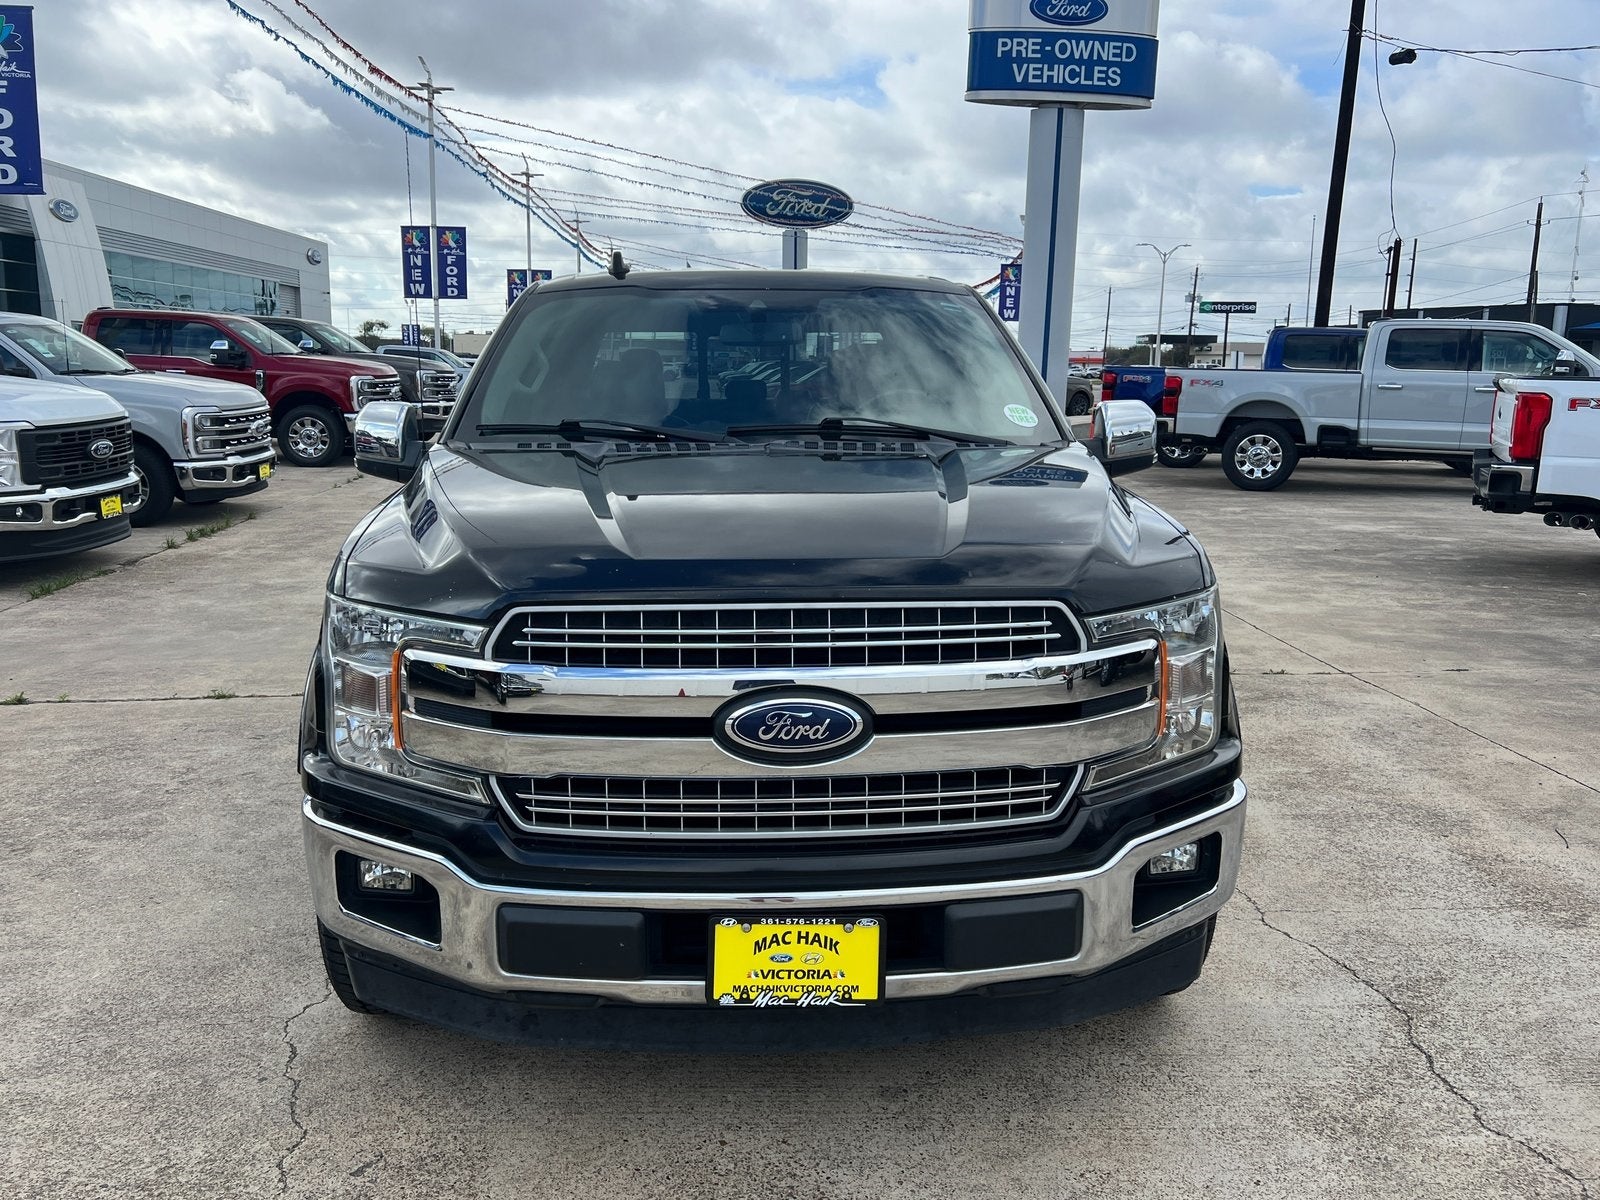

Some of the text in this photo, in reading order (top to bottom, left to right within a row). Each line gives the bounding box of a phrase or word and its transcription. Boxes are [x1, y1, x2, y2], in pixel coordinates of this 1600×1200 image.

[1012, 63, 1121, 87] VEHICLES
[766, 188, 830, 216] Ford
[410, 254, 425, 295] NEW
[445, 255, 459, 297] FORD
[1003, 286, 1016, 319] NEW
[1201, 303, 1256, 312] enterprise
[1189, 378, 1224, 387] FX4
[758, 710, 831, 740] Ford
[753, 931, 840, 955] MAC HAIK
[760, 969, 832, 979] VICTORIA
[732, 984, 859, 993] MACHAIKVICTORIACOM
[753, 990, 844, 1008] Mac Haik
